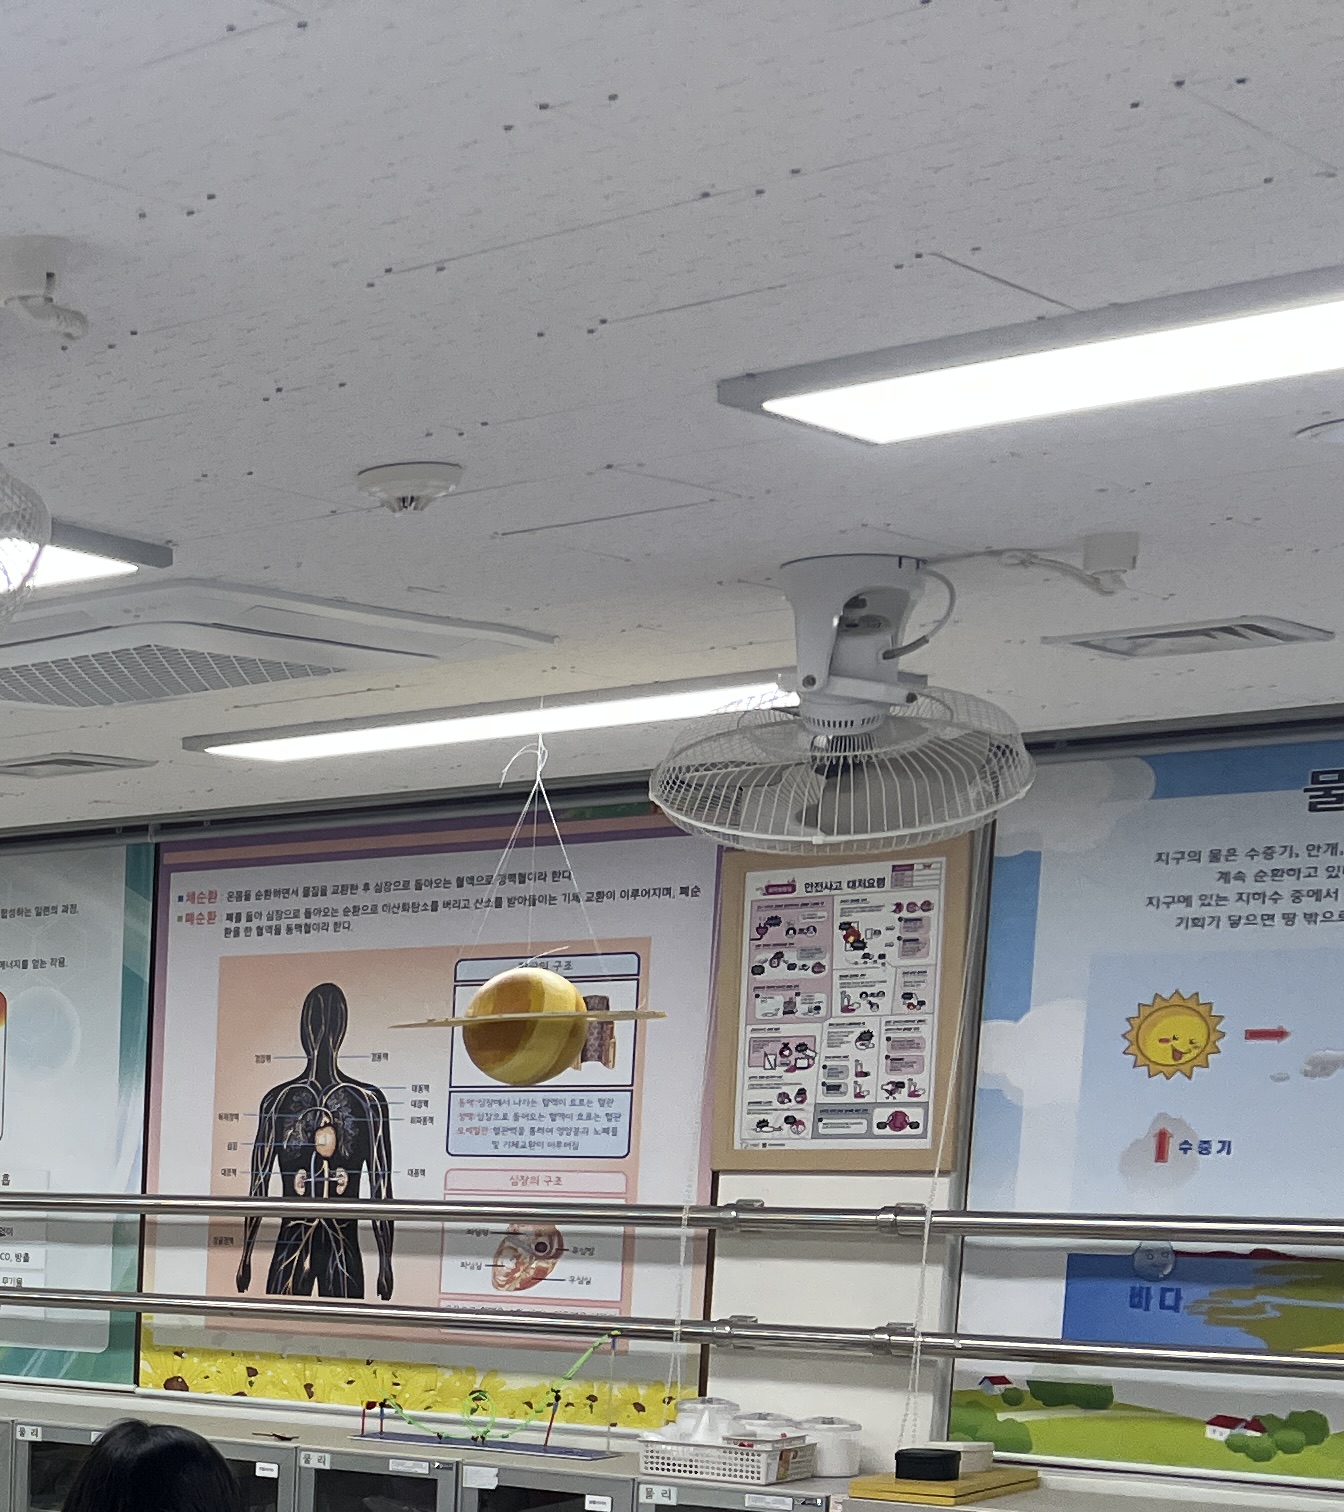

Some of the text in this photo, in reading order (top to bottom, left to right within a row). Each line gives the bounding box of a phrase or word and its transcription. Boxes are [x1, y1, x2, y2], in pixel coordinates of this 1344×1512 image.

[1155, 849, 1202, 865] 지구의
[1208, 848, 1238, 862] 물은
[1216, 865, 1344, 884] 계속 순환하고 있
[255, 887, 299, 901] 순환하면서
[302, 885, 328, 898] 물질을
[374, 880, 411, 893] 심장으로
[414, 877, 452, 891] 돌아오는
[804, 880, 843, 894] 안전사고
[266, 907, 301, 921] 심장으로
[304, 906, 339, 919] 돌아오는
[342, 903, 379, 917] 순환으로
[381, 900, 439, 915] 이산화탄소를
[585, 889, 615, 903] 교환이
[1146, 887, 1339, 909] 지구에 있는 지하수 중에서
[1175, 915, 1221, 930] 기회가
[1282, 912, 1298, 927] 땅
[552, 961, 573, 972] 구조
[1178, 1139, 1233, 1156] 수증기
[509, 1175, 564, 1187] 심장의 구조
[1129, 1285, 1183, 1313] 바다
